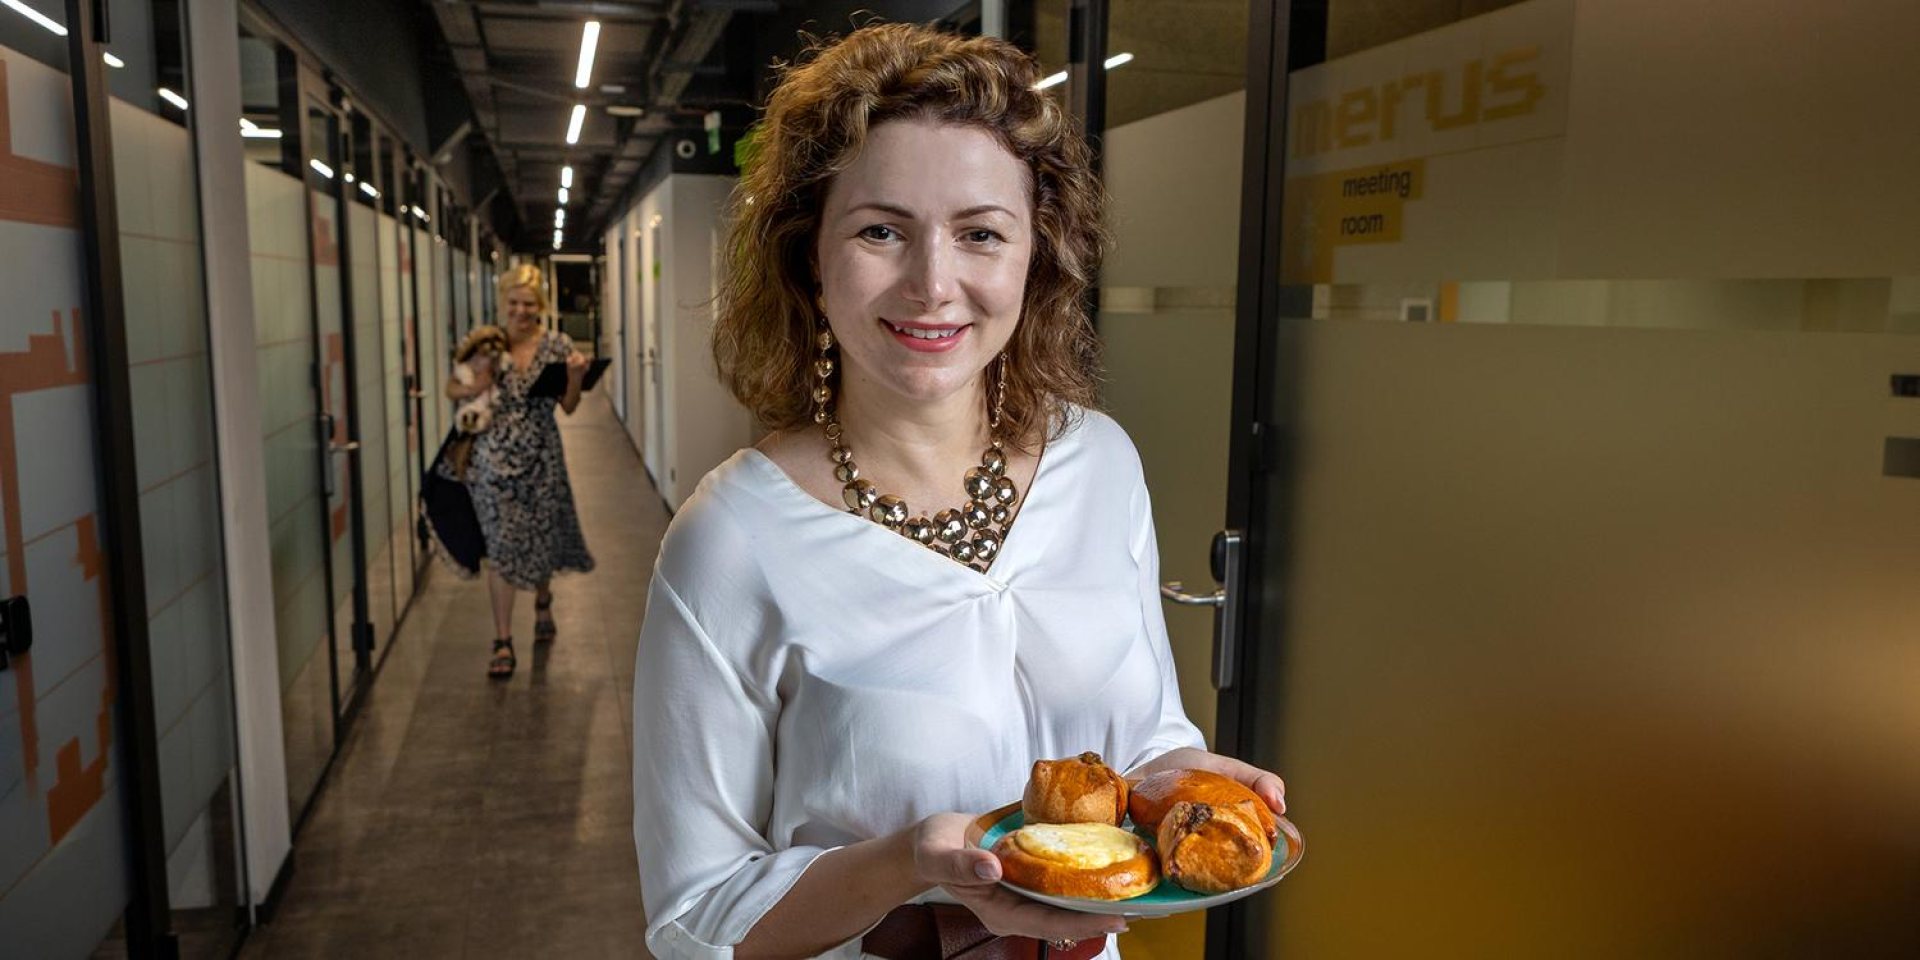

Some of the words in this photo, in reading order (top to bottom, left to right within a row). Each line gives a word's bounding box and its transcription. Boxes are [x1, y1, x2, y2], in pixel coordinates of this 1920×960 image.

[1292, 45, 1546, 158] merus
[1342, 168, 1412, 198] meeting
[1340, 213, 1384, 236] room
